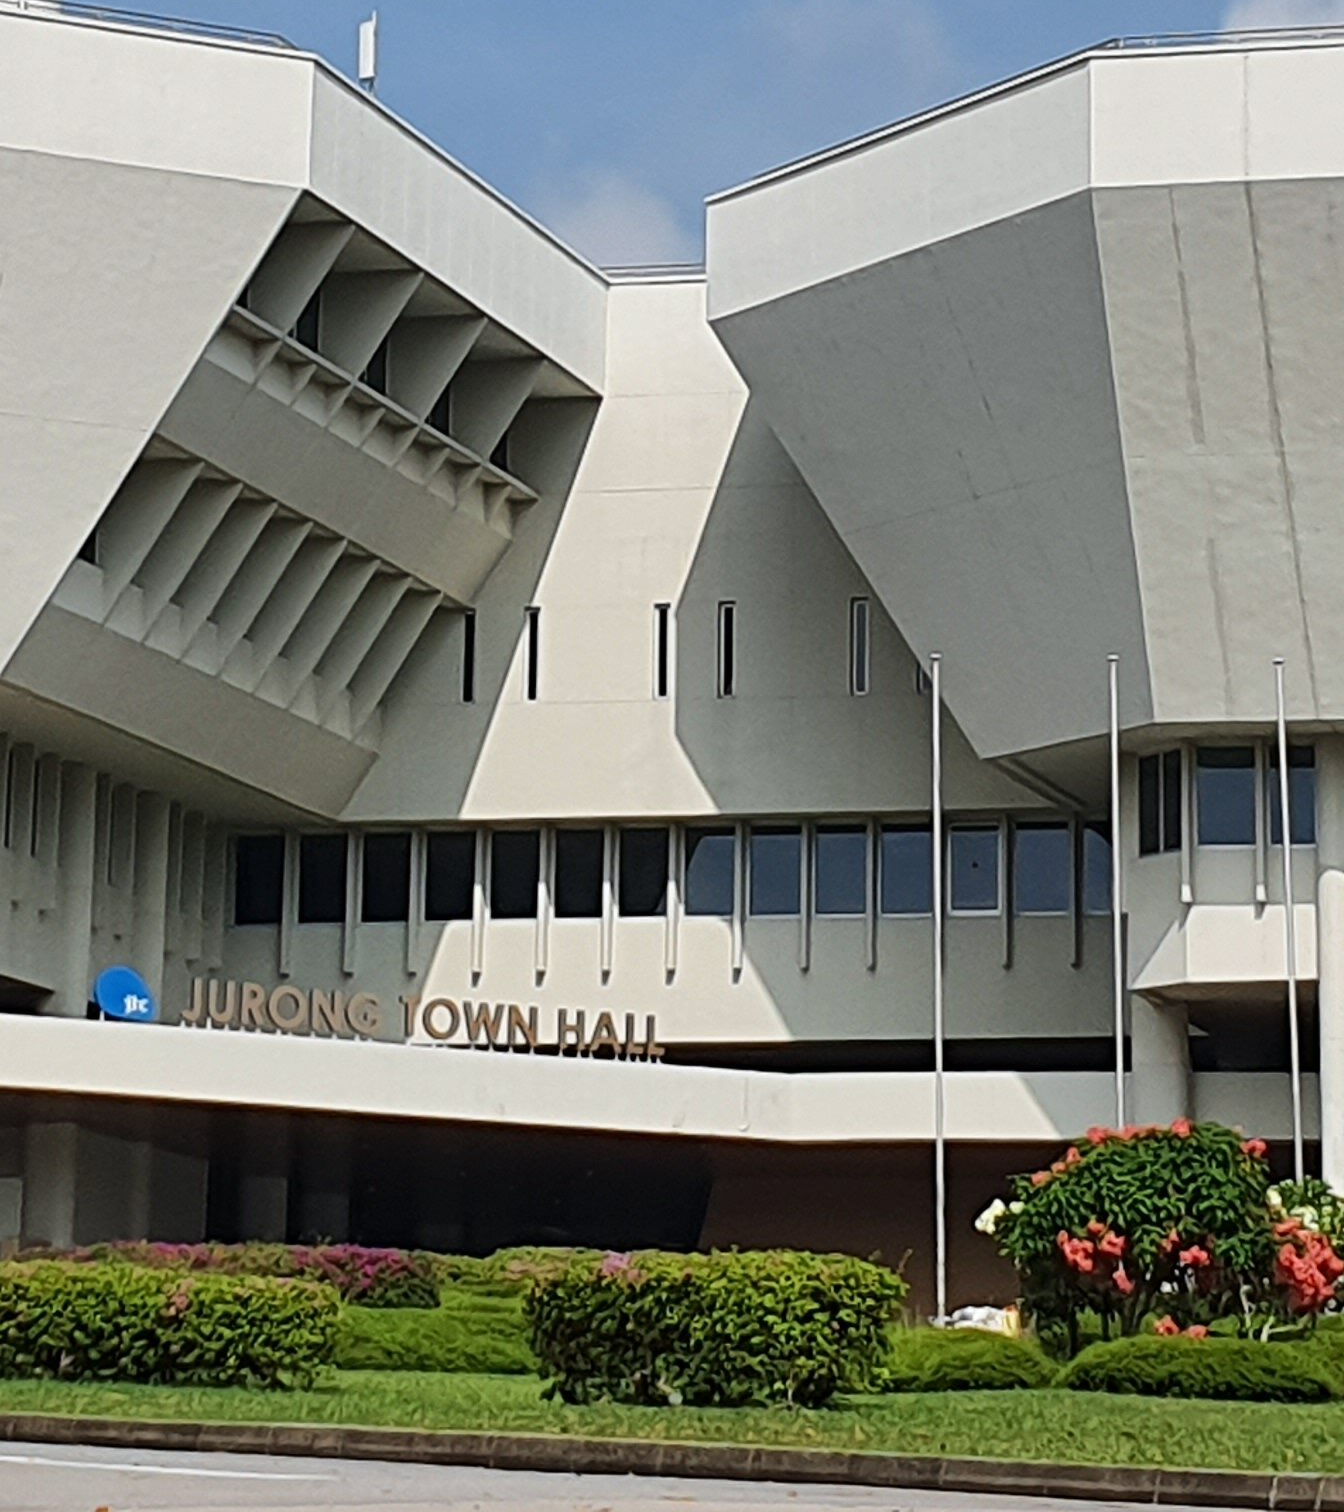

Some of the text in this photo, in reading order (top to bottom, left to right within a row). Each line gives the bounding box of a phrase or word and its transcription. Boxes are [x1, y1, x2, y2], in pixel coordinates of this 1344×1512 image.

[180, 976, 665, 1055] JURONG TOWN HALL
